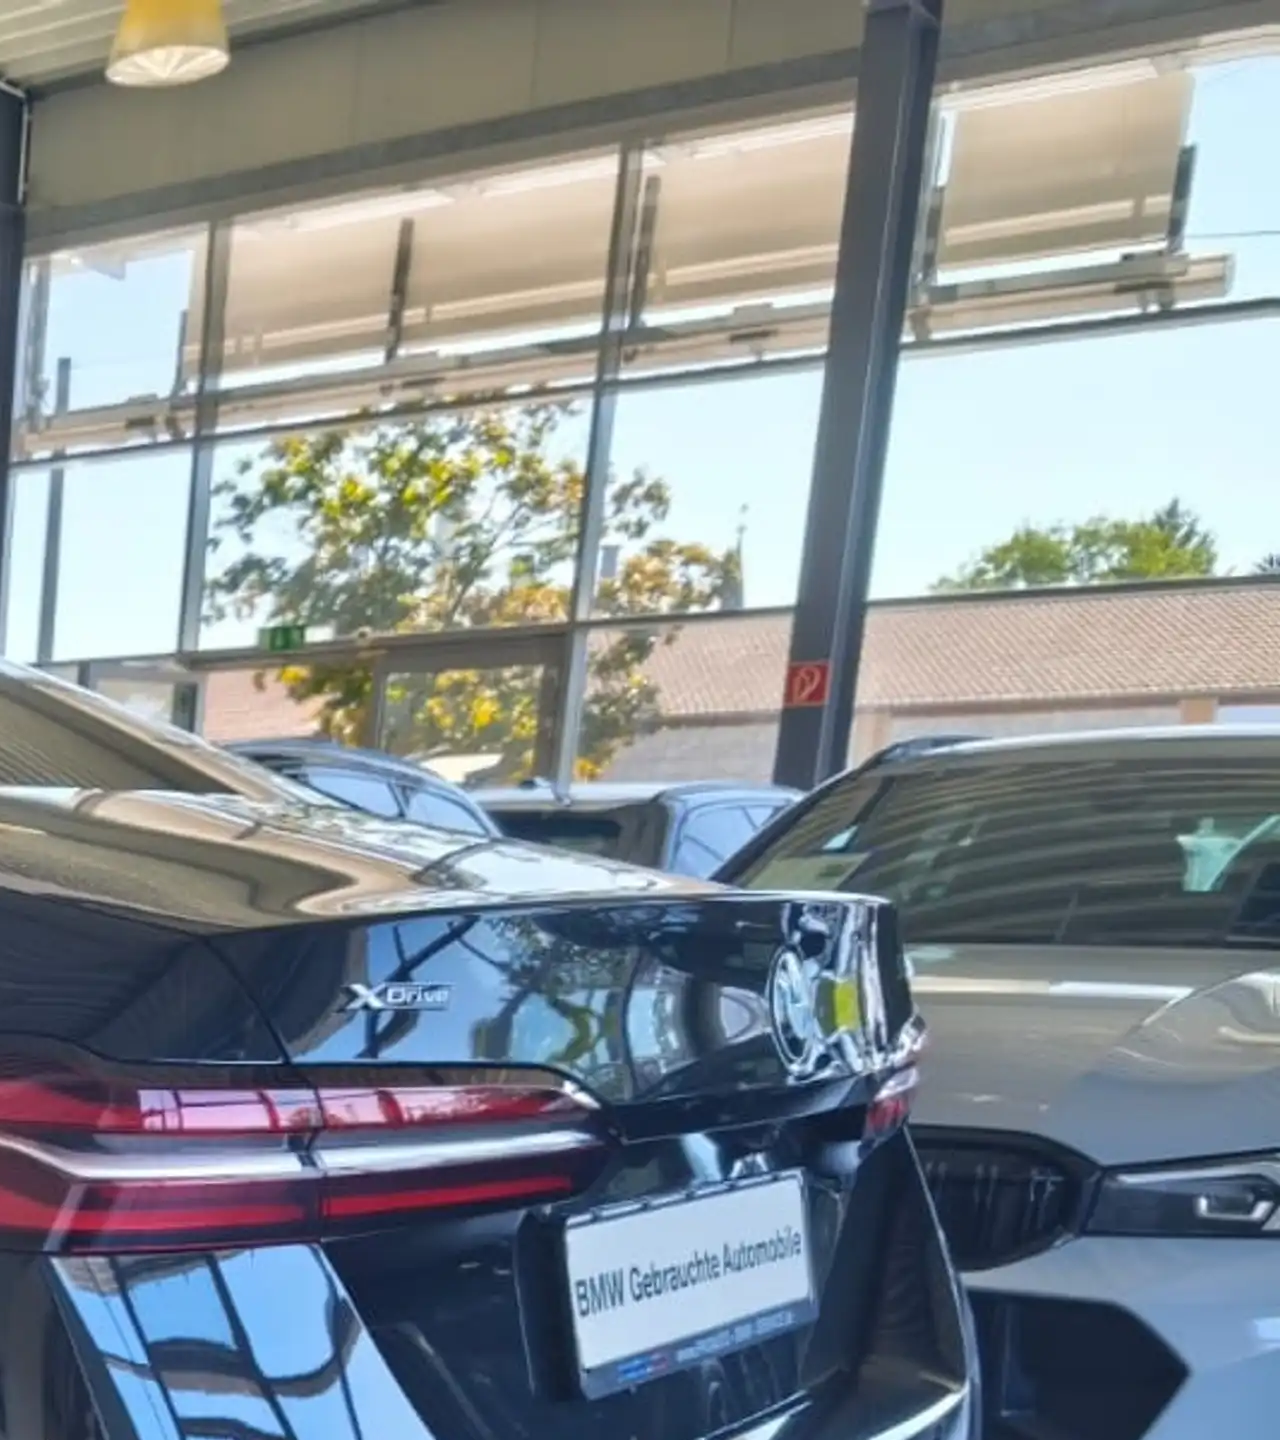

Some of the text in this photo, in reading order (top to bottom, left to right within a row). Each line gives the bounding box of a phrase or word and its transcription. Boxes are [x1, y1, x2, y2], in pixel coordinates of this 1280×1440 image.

[575, 1225, 802, 1317] BMW Gebrauchte Automobile
